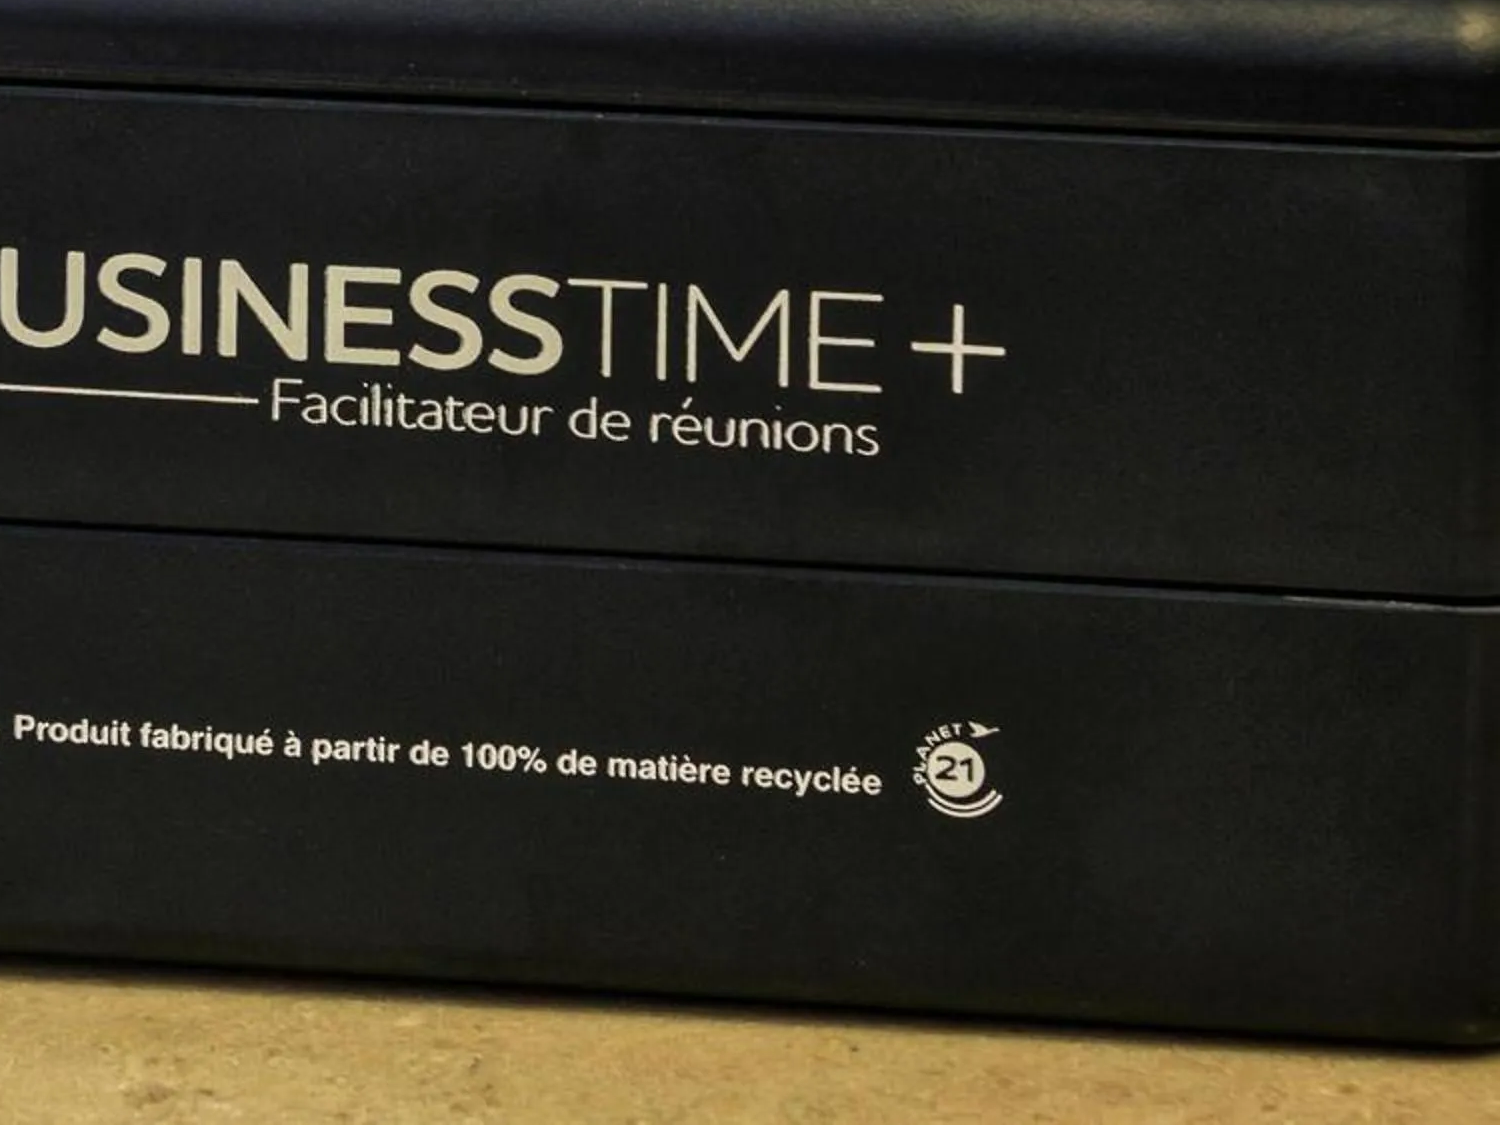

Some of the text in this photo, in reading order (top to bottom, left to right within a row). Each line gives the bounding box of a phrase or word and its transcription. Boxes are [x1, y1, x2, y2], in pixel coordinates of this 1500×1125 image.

[271, 377, 880, 456] Facilitateur de réunions
[13, 713, 883, 798] Produit fabriqué à partir de 100% de matière recyclée
[912, 722, 963, 786] PLANET
[934, 755, 974, 783] 21
